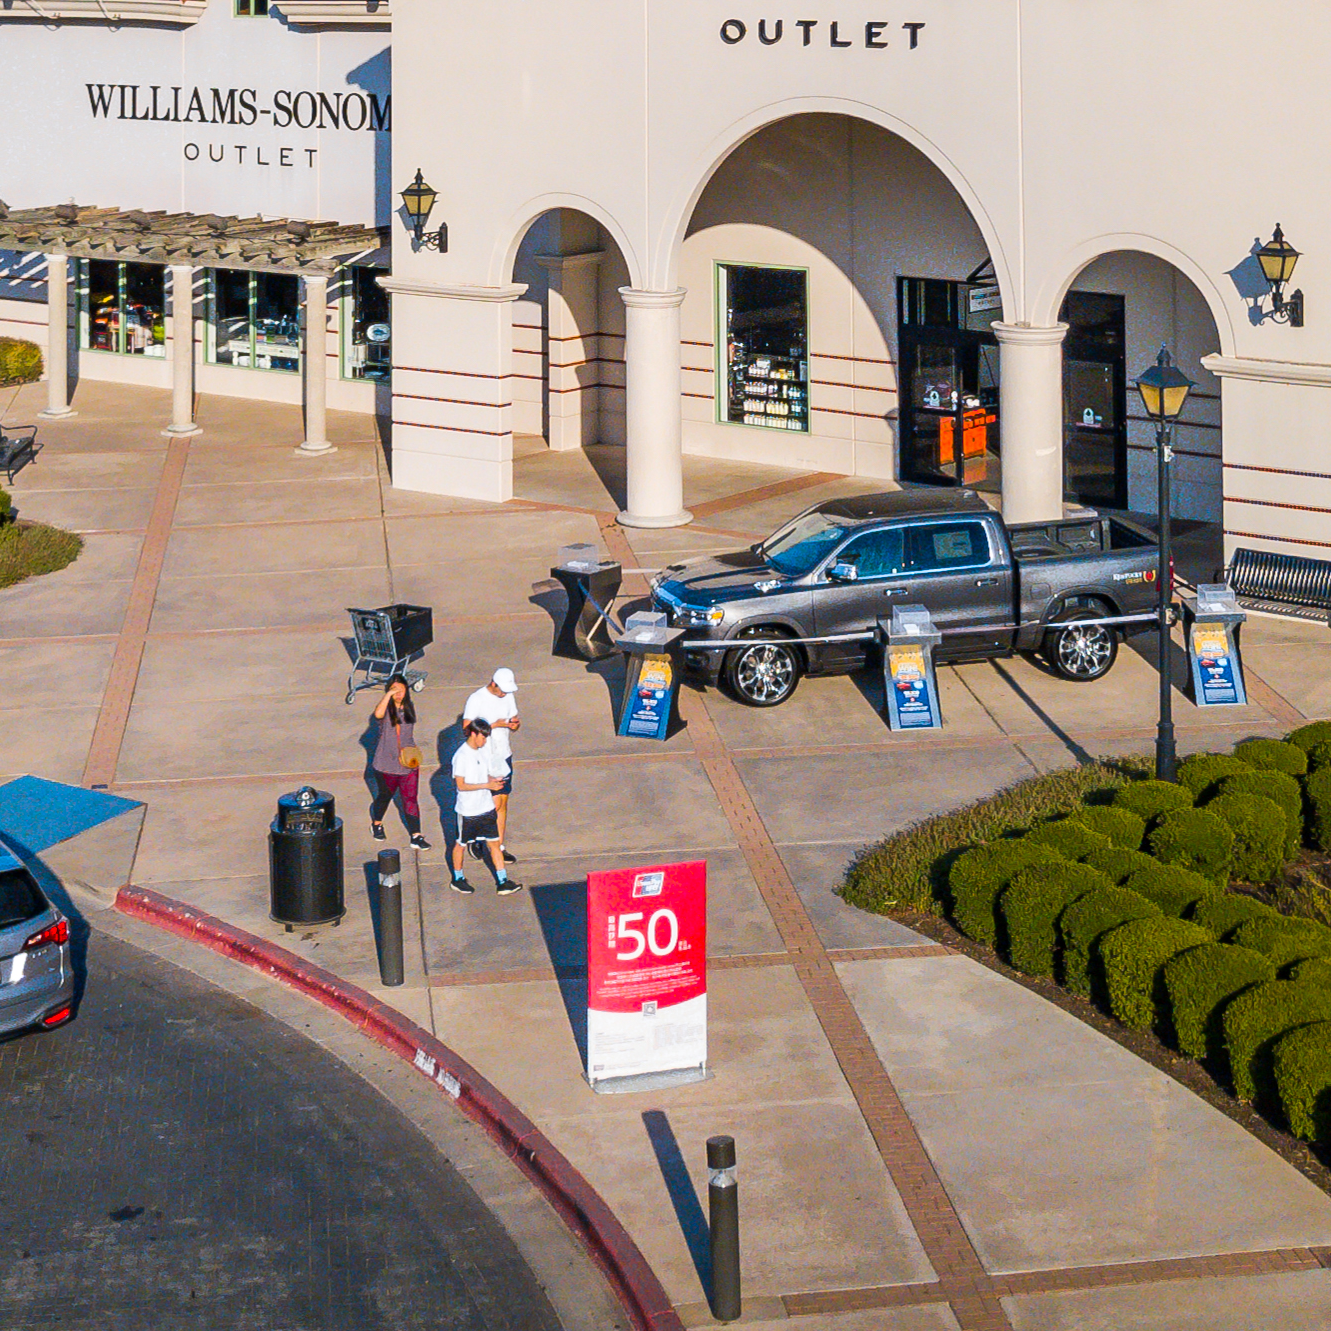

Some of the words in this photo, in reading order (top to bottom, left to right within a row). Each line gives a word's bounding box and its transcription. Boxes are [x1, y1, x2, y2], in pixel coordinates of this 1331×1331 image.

[719, 17, 927, 50] OUTLET
[183, 142, 319, 169] OUTLET
[616, 908, 679, 961] 50
